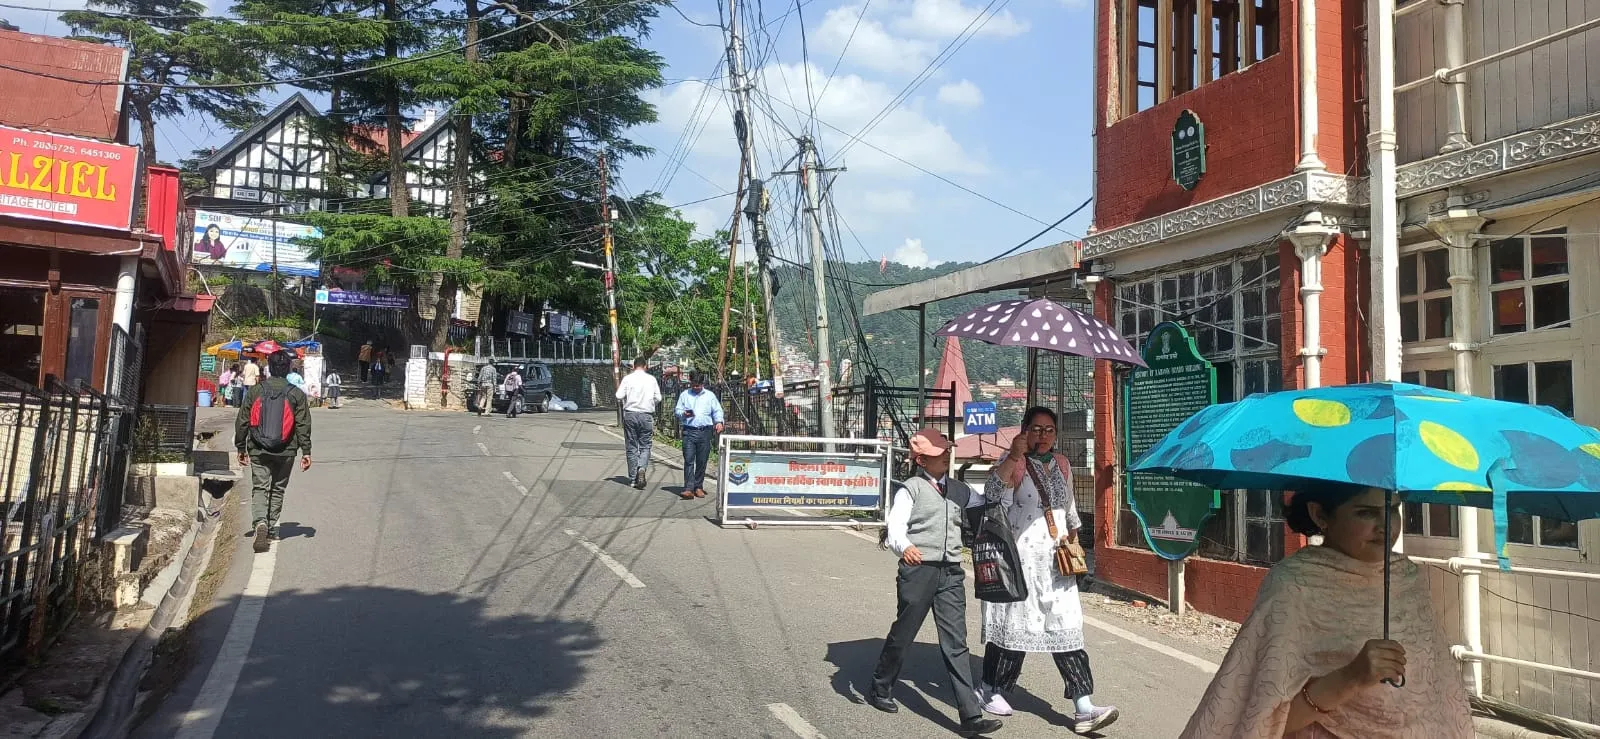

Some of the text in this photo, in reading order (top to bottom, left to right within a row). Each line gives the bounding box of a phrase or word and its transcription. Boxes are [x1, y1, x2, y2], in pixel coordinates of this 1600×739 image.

[13, 137, 29, 147] Ph.
[81, 148, 121, 160] 6451306
[966, 413, 996, 426] ATM
